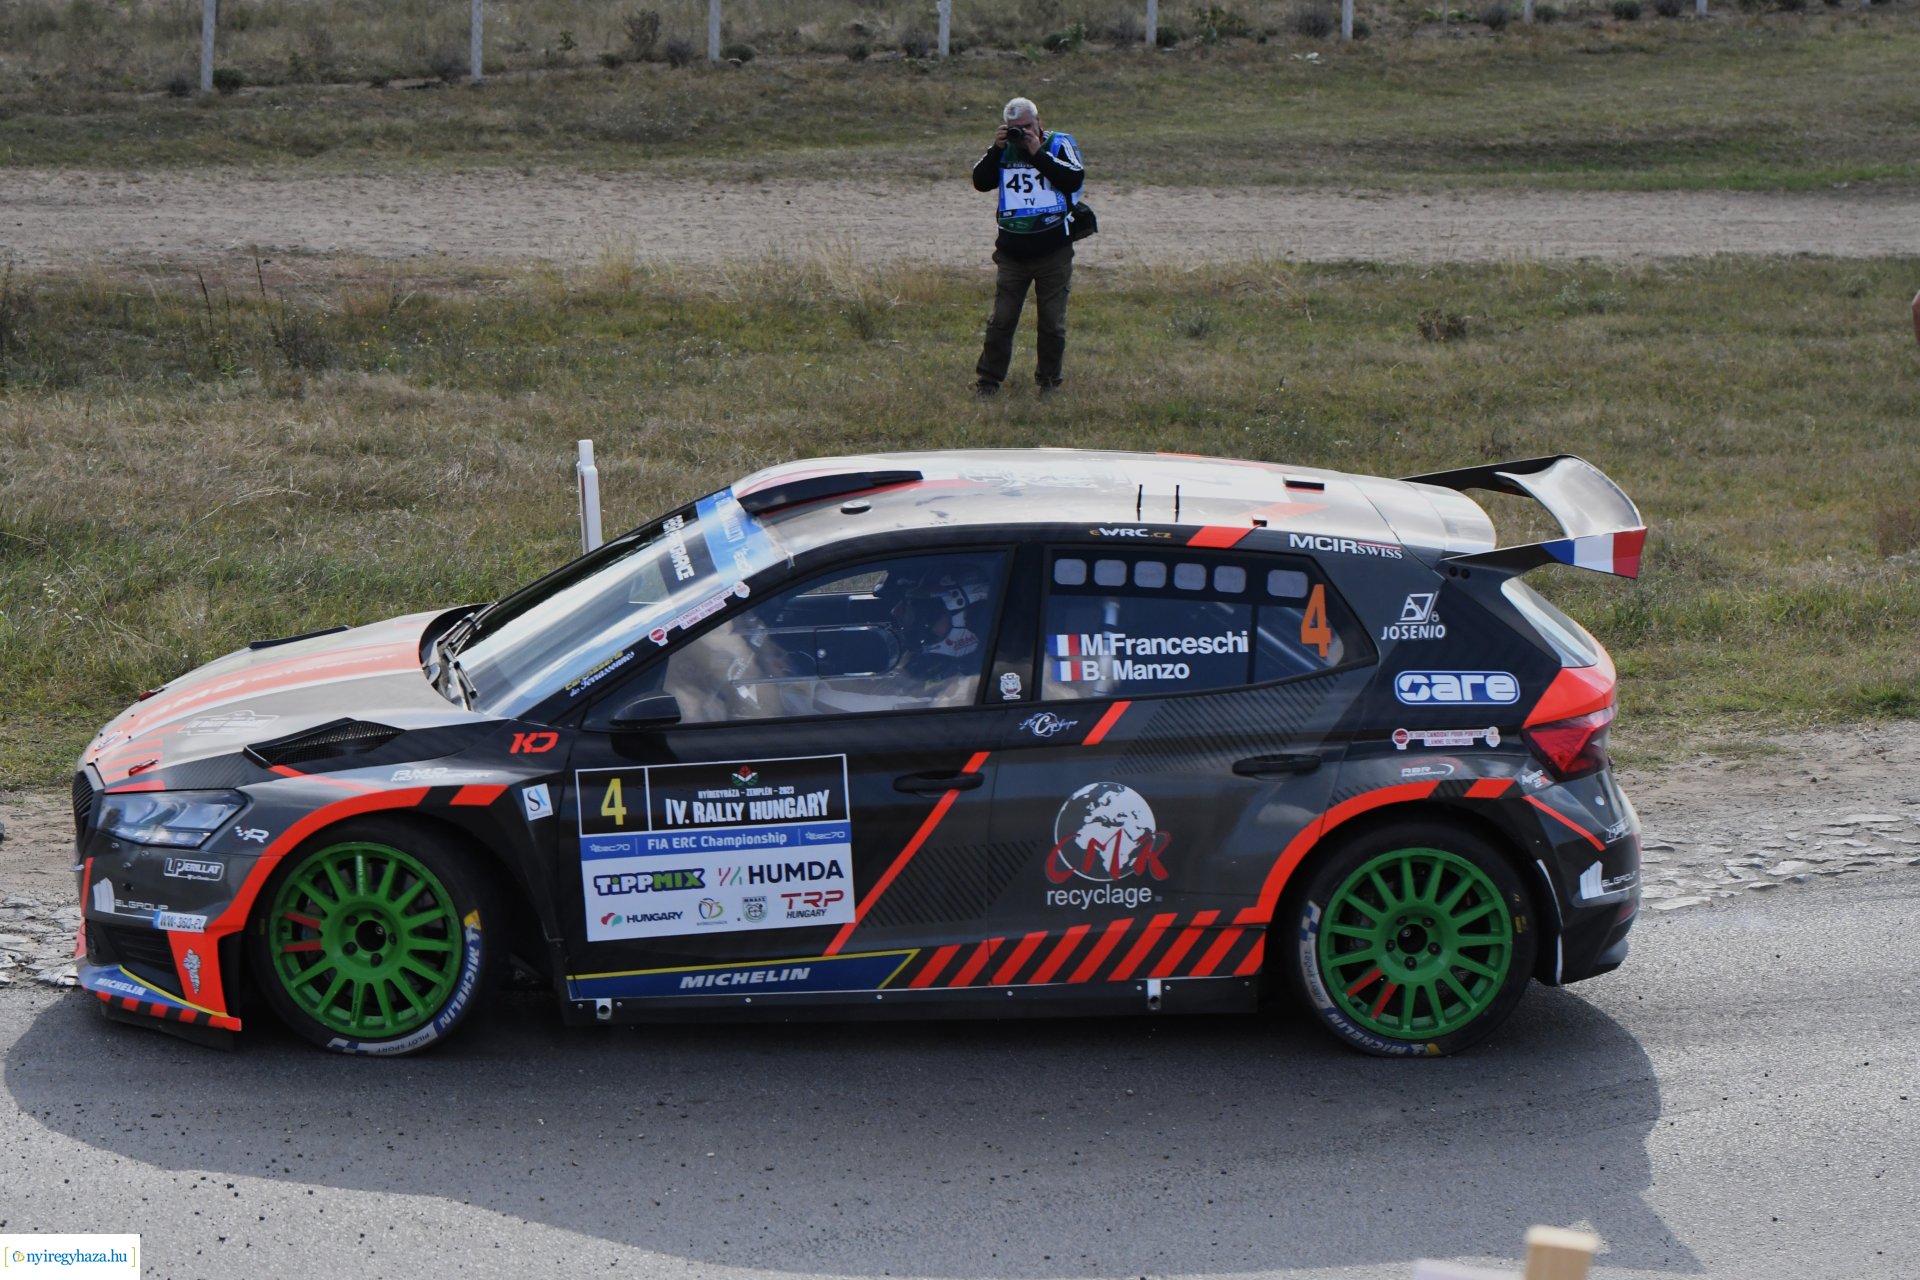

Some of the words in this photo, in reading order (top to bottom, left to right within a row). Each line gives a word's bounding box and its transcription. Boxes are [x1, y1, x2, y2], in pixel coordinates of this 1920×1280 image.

[1006, 173, 1046, 194] 451
[1023, 198, 1036, 206] TV
[1300, 583, 1332, 658] 4
[1380, 624, 1447, 641] JOSENIO
[1083, 661, 1106, 681] B.
[1112, 660, 1190, 681] Manzo
[600, 777, 627, 826] 4
[665, 797, 691, 826] IV.
[692, 801, 744, 824] RALLY
[749, 789, 830, 821] HUNGARY
[647, 837, 669, 851] FIA
[672, 835, 698, 850] ERC
[700, 831, 788, 849] Championship
[1045, 828, 1172, 884] CMR
[748, 859, 845, 885] HUMDA
[781, 889, 845, 910] TRP
[1047, 884, 1153, 911] recyclage
[626, 910, 684, 924] HUNGARY
[786, 907, 828, 920] HUNGARY
[94, 977, 148, 996] MICHELIN
[437, 943, 481, 1029] MICHELIN
[679, 967, 811, 989] MICHELIN
[1327, 1012, 1408, 1055] MICHELIN
